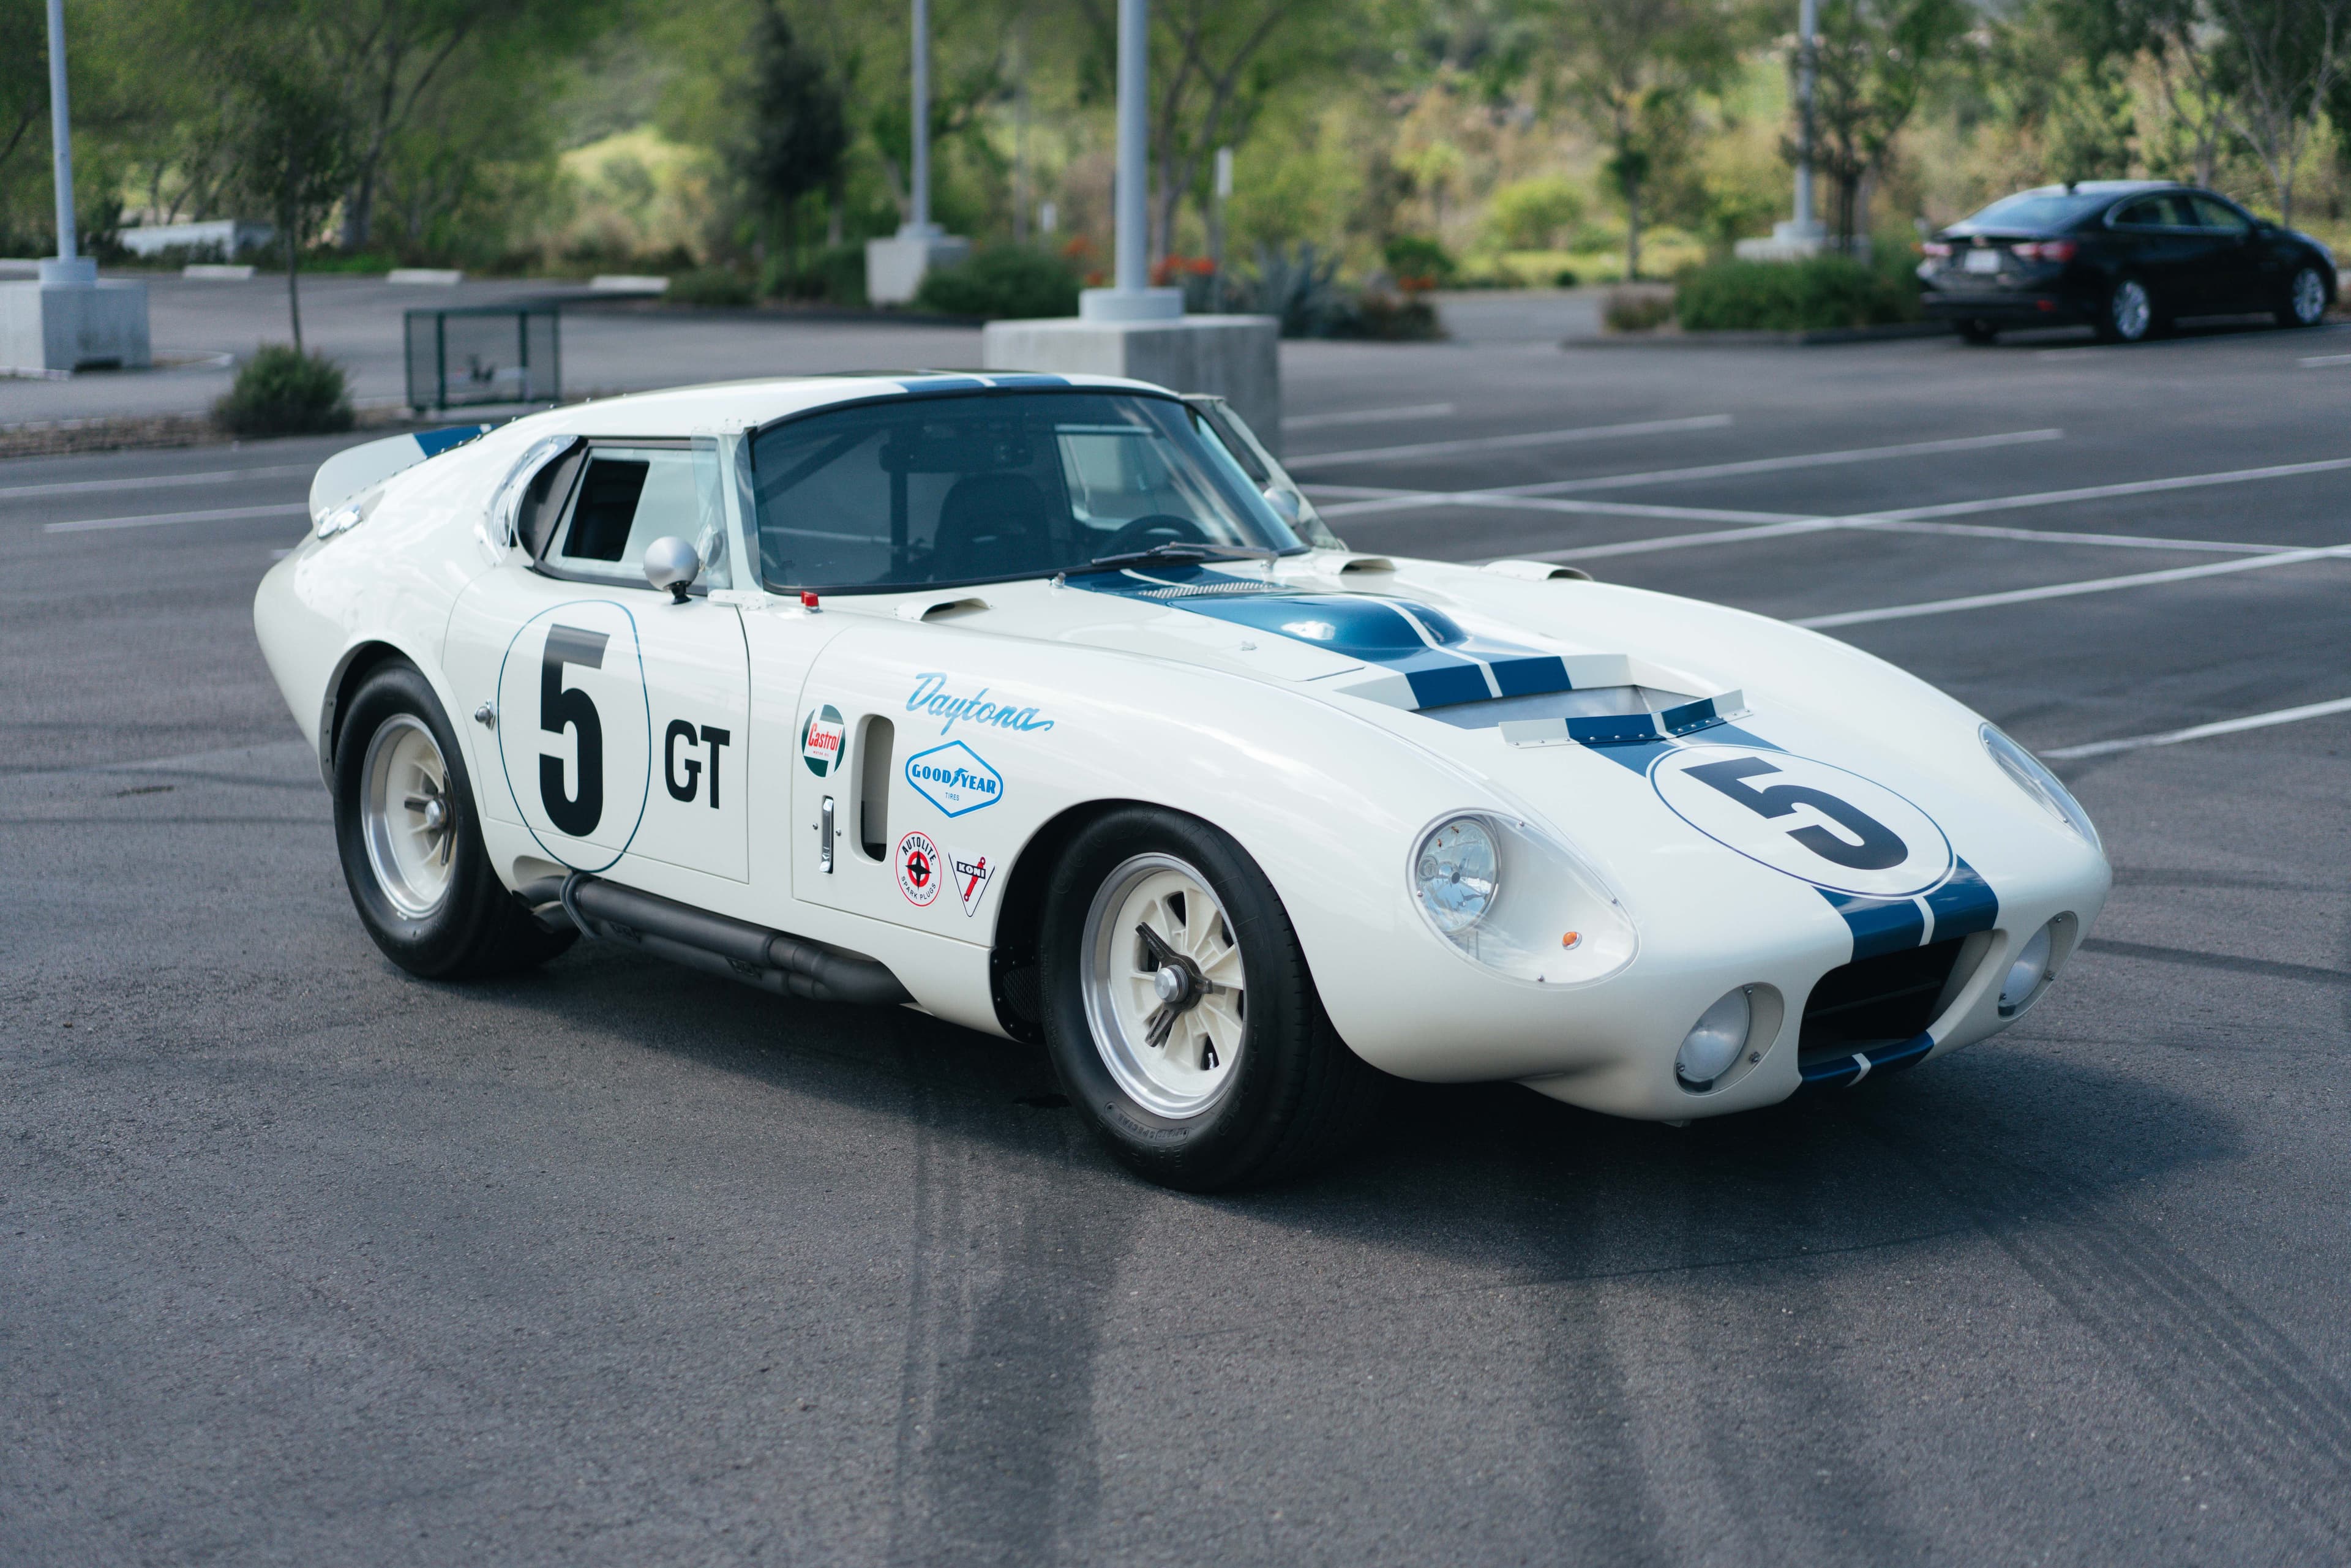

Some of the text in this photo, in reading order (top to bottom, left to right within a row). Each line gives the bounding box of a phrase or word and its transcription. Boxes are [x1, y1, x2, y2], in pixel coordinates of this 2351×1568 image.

[906, 672, 1055, 736] Daytona
[539, 623, 610, 837] 5
[809, 722, 841, 751] Castrol
[664, 719, 730, 809] GT
[945, 792, 960, 801] TIRES
[1679, 756, 1908, 871] 5
[901, 876, 936, 901] SPARK PLUGS
[958, 861, 985, 879] KONI
